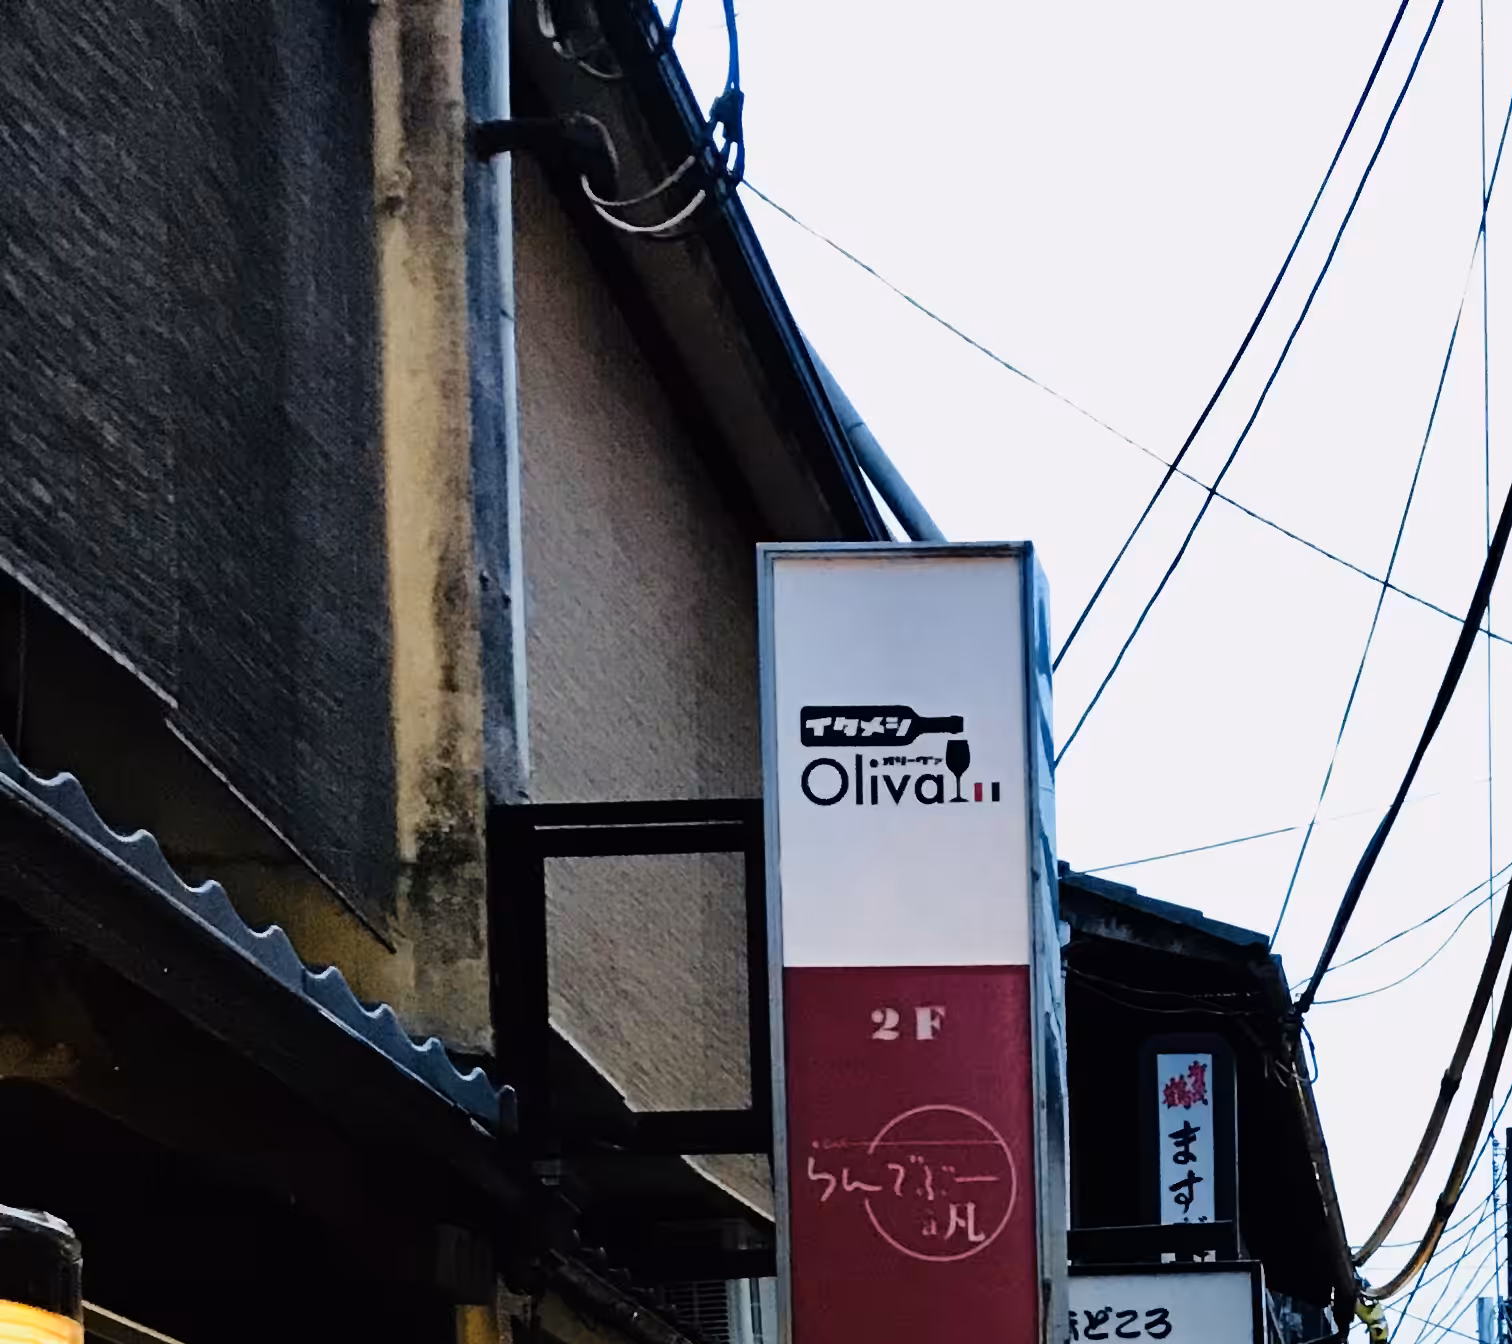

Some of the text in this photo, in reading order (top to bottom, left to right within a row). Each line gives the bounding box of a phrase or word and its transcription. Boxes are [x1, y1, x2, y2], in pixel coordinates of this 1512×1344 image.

[805, 716, 912, 737] イタメシ
[801, 753, 945, 807] Oliva
[1167, 1119, 1208, 1223] ます
